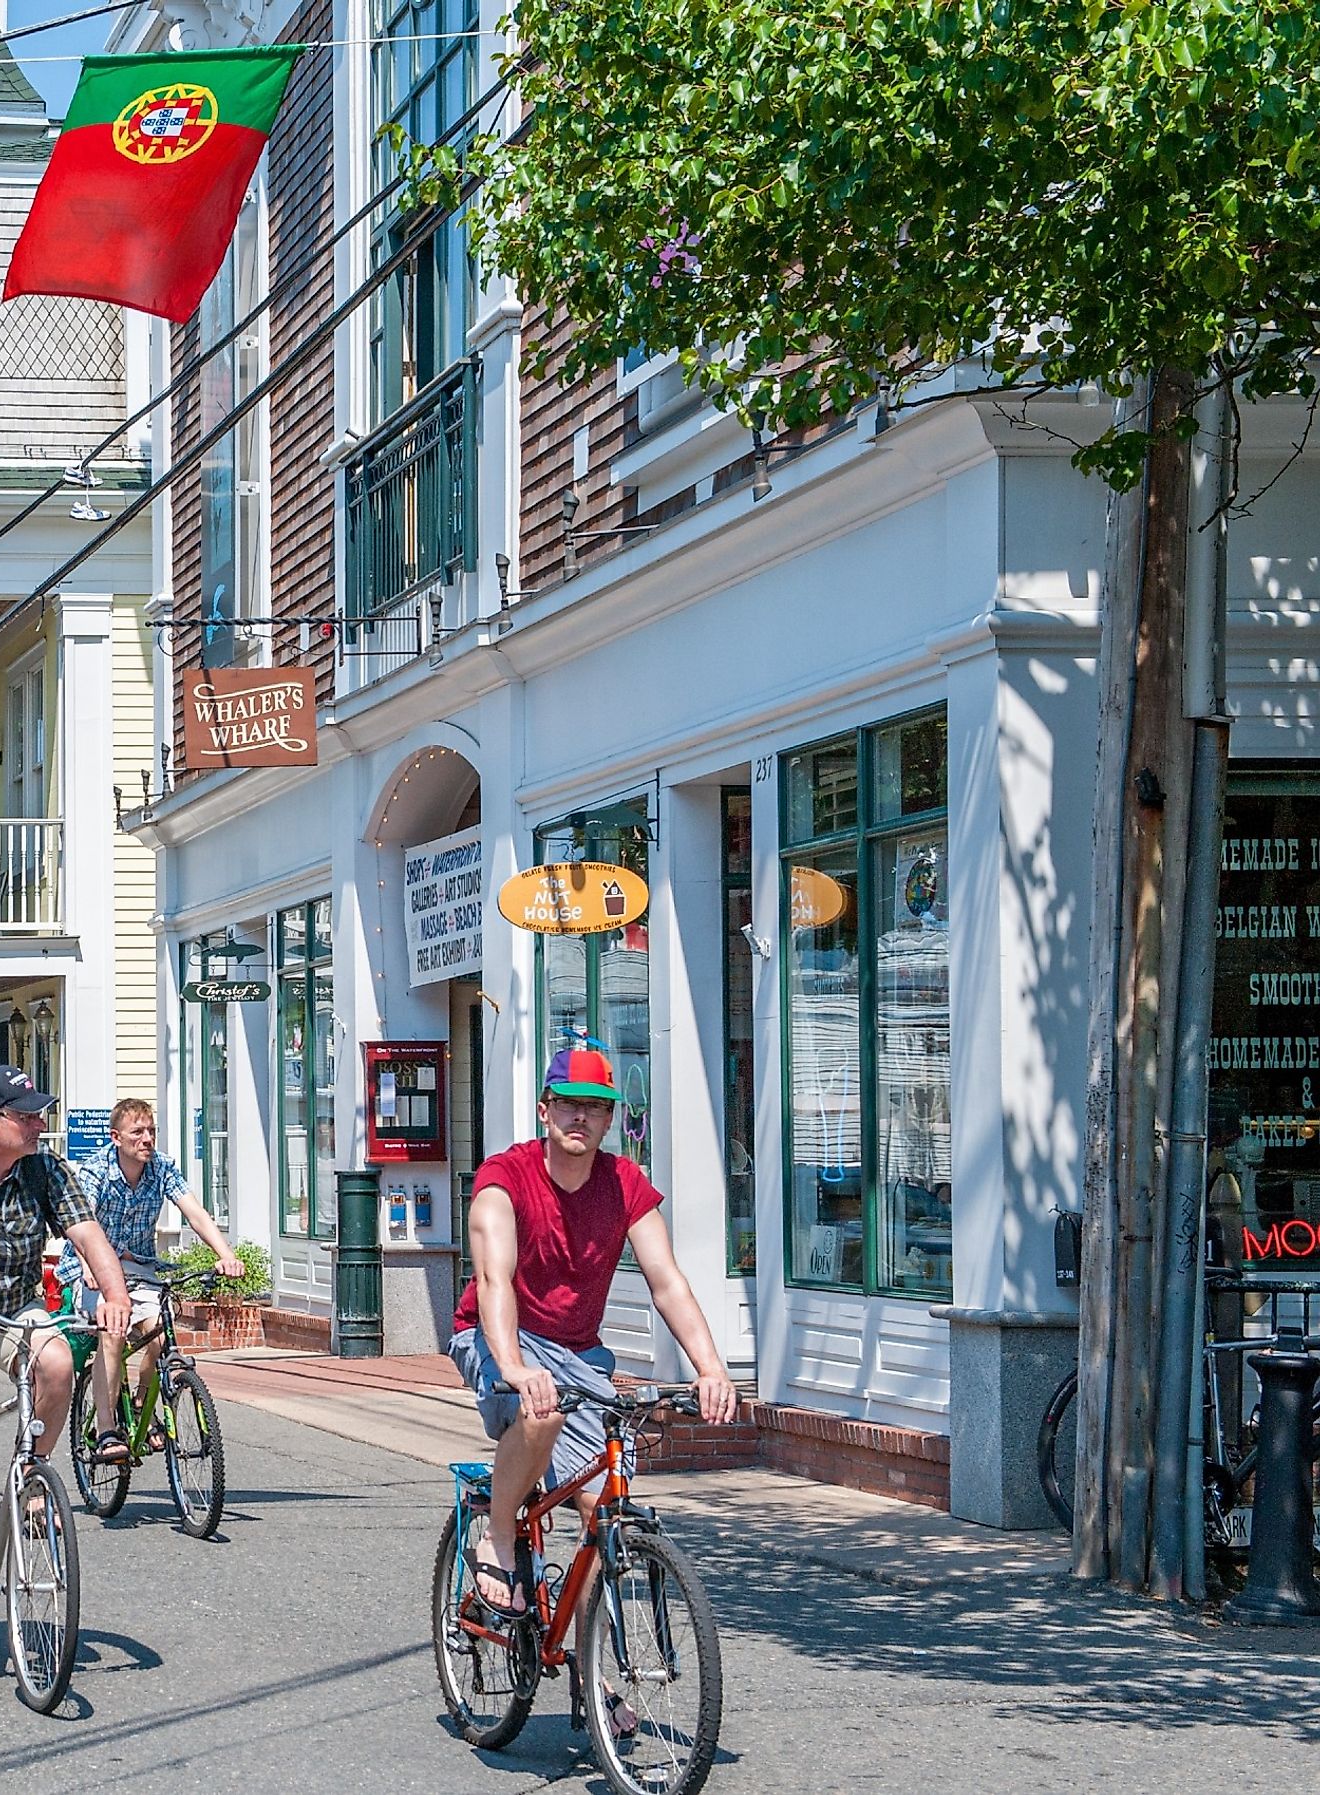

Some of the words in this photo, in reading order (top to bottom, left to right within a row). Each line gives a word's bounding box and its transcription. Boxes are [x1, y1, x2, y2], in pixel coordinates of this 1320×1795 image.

[194, 686, 304, 722] WHALER'S
[209, 715, 291, 748] WHARF
[756, 755, 773, 783] 237
[1310, 838, 1320, 870] I
[411, 882, 439, 914] GALLERIES
[444, 876, 456, 904] ART
[534, 890, 571, 906] NUT
[539, 876, 566, 889] The
[420, 911, 448, 941] MASSAGE
[454, 904, 477, 932] BEACH
[1306, 906, 1320, 938] W
[417, 947, 430, 972] FREE
[430, 944, 442, 970] ART
[442, 937, 466, 966] EXHIBIT
[192, 982, 261, 998] Christof's
[1250, 972, 1320, 1006] SMOOT
[1206, 1037, 1320, 1070] HOMEMADE
[1302, 1076, 1316, 1109] &
[1240, 1115, 1308, 1147] BAKED
[1242, 1220, 1320, 1261] MO
